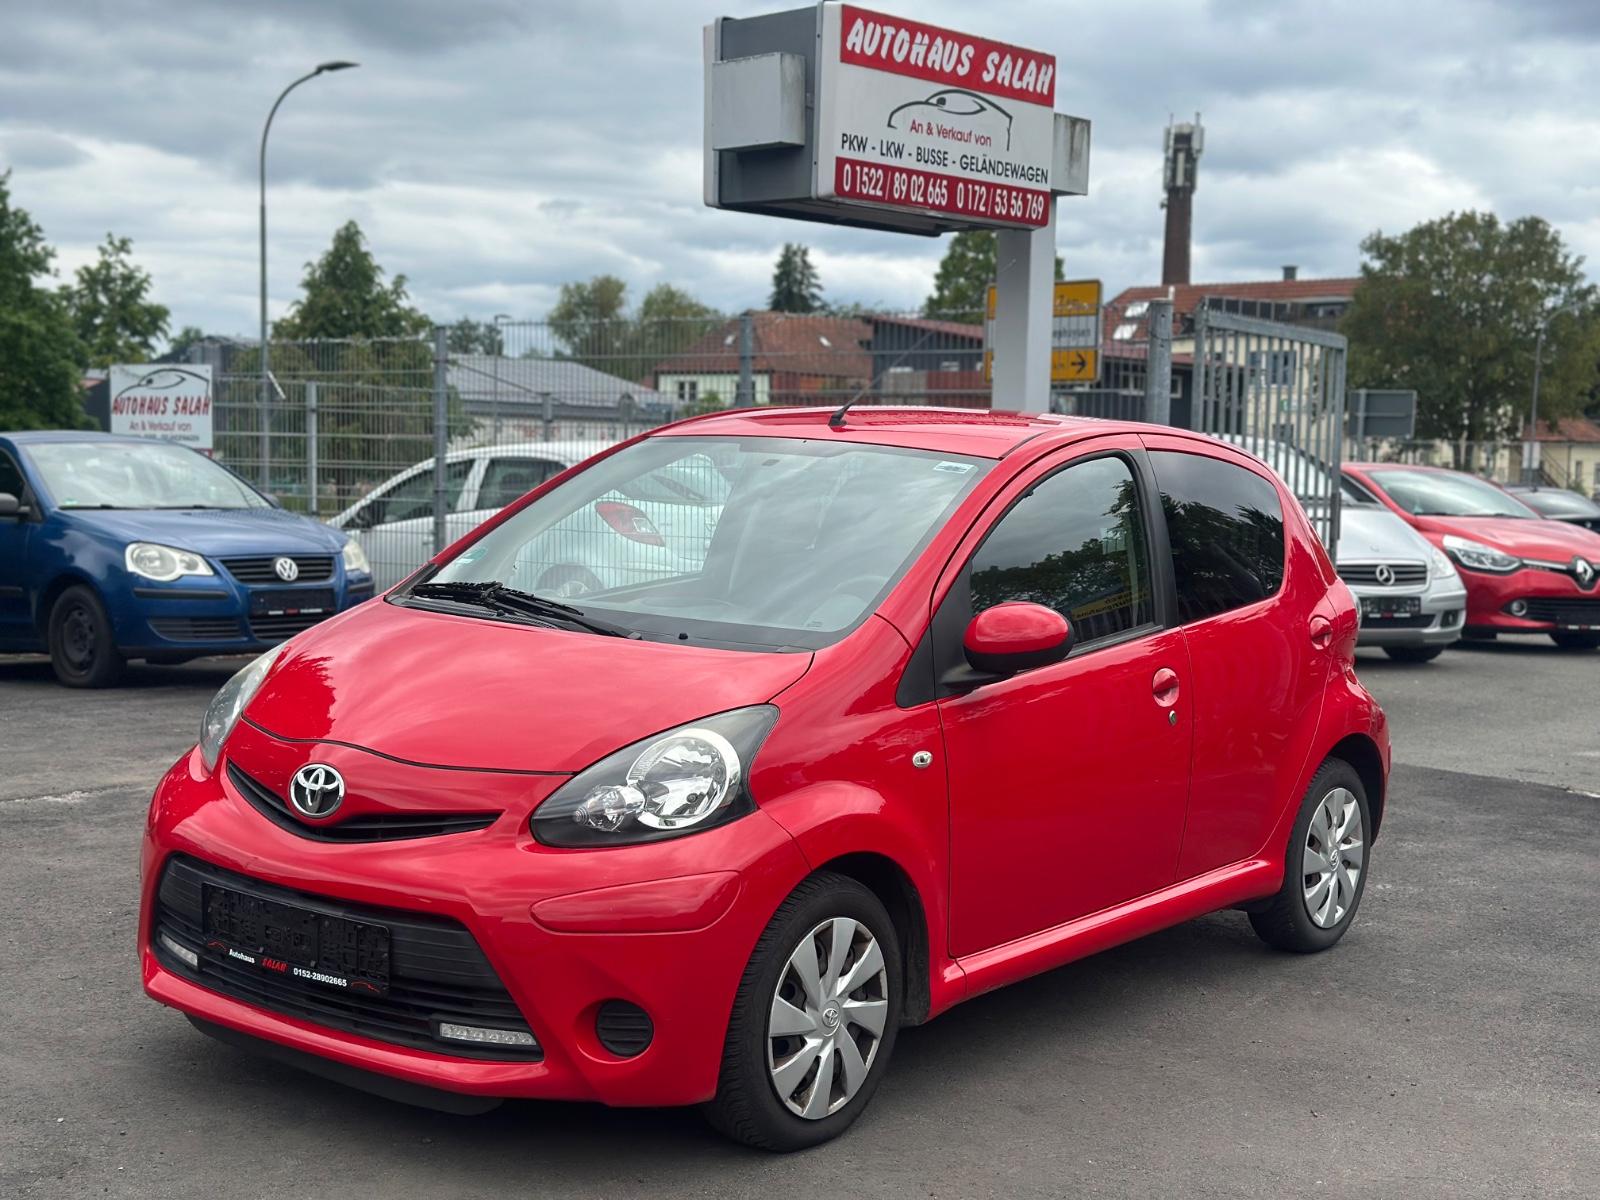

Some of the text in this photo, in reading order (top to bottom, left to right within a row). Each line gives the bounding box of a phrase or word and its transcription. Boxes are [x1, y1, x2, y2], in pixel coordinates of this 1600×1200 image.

[846, 17, 1054, 96] AUTOHAUS SALAH
[910, 119, 992, 147] An & Verkauf von
[841, 133, 868, 152] PKW
[880, 139, 905, 159] LKW
[916, 146, 949, 168] BUSSE
[959, 153, 1049, 185] GELÄNDEWAGEN
[843, 163, 852, 193] 0
[856, 165, 884, 197] 1522
[893, 171, 908, 200] 89
[910, 174, 924, 203] 02
[927, 177, 949, 207] 665
[956, 182, 964, 209] 0
[967, 184, 987, 213] 172
[994, 188, 1008, 216] 53
[1010, 191, 1023, 218] 56
[1025, 194, 1045, 221] 769
[112, 396, 211, 416] AUTOHAUS SALAH
[129, 421, 139, 431] An
[148, 421, 176, 431] Verkauf
[177, 422, 192, 431] von
[229, 948, 256, 964] Autohaus
[293, 967, 348, 987] 0152-28902665
